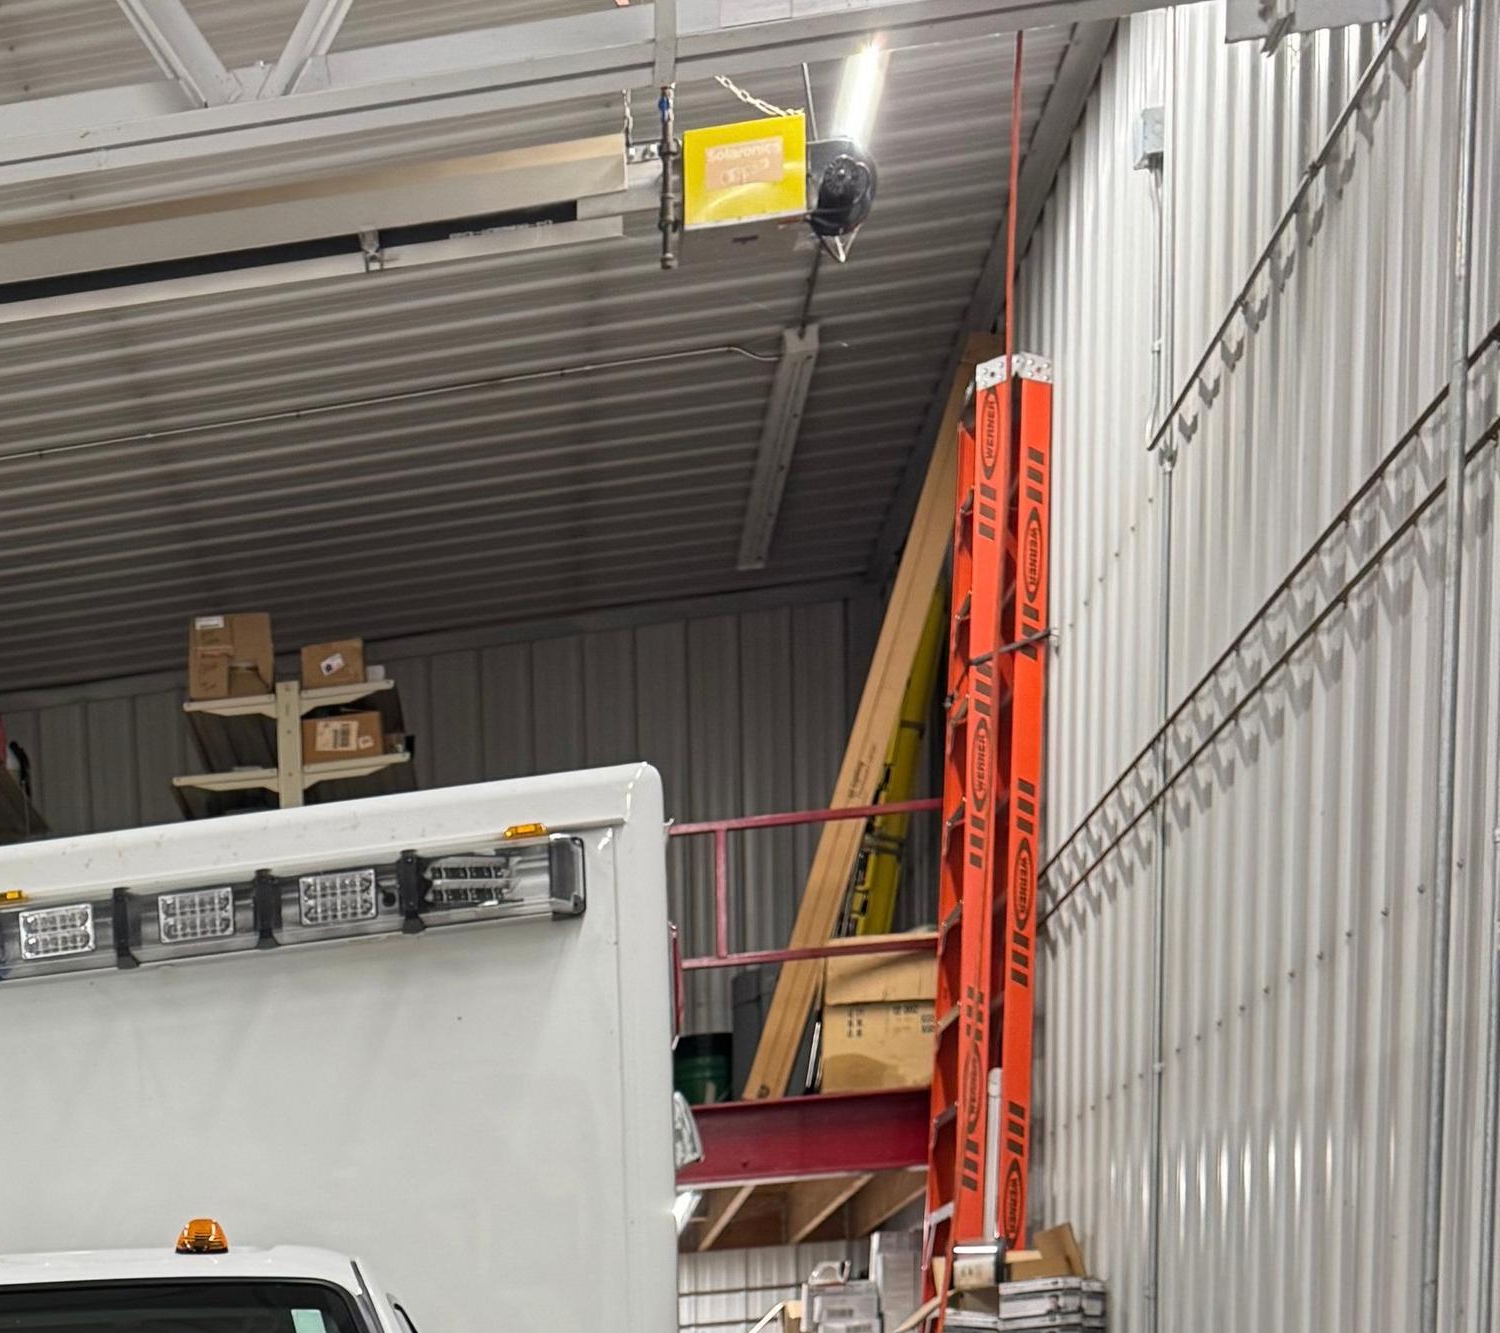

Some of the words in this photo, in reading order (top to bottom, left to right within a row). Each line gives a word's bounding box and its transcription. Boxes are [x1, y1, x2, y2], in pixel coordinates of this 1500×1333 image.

[985, 399, 996, 460] WERNER
[1028, 526, 1039, 586] WERNER
[975, 734, 987, 792] WERNER
[1018, 858, 1029, 914] WERNER
